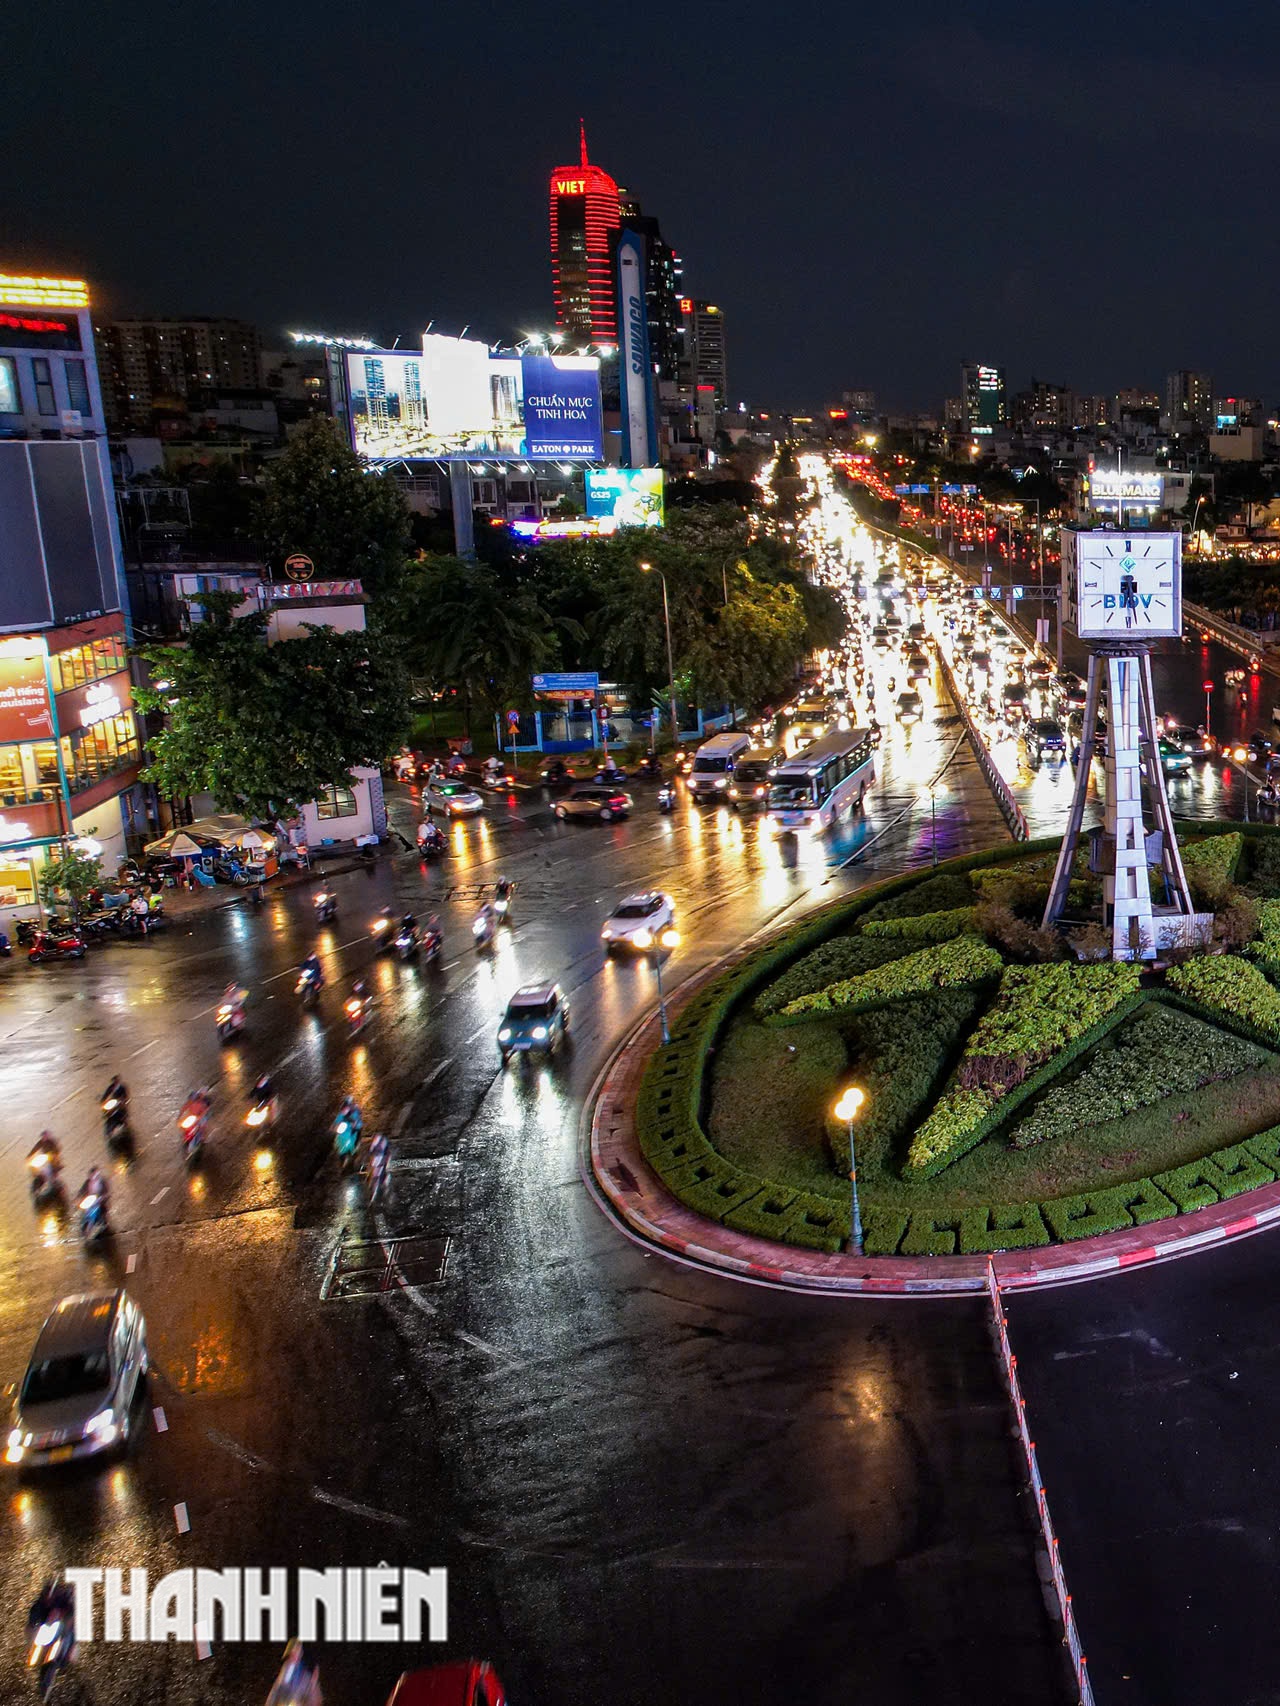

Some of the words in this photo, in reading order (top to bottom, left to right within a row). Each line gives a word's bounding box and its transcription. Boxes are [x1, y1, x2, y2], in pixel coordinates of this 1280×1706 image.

[557, 181, 585, 193] VIET
[629, 296, 644, 377] SAWACO
[528, 394, 565, 407] CHUẨN
[568, 397, 593, 408] MỰC
[536, 409, 560, 419] TINH
[564, 409, 587, 419] HOA
[532, 445, 561, 453] EATON
[572, 445, 594, 453] PARK
[0, 697, 45, 708] ouisiana
